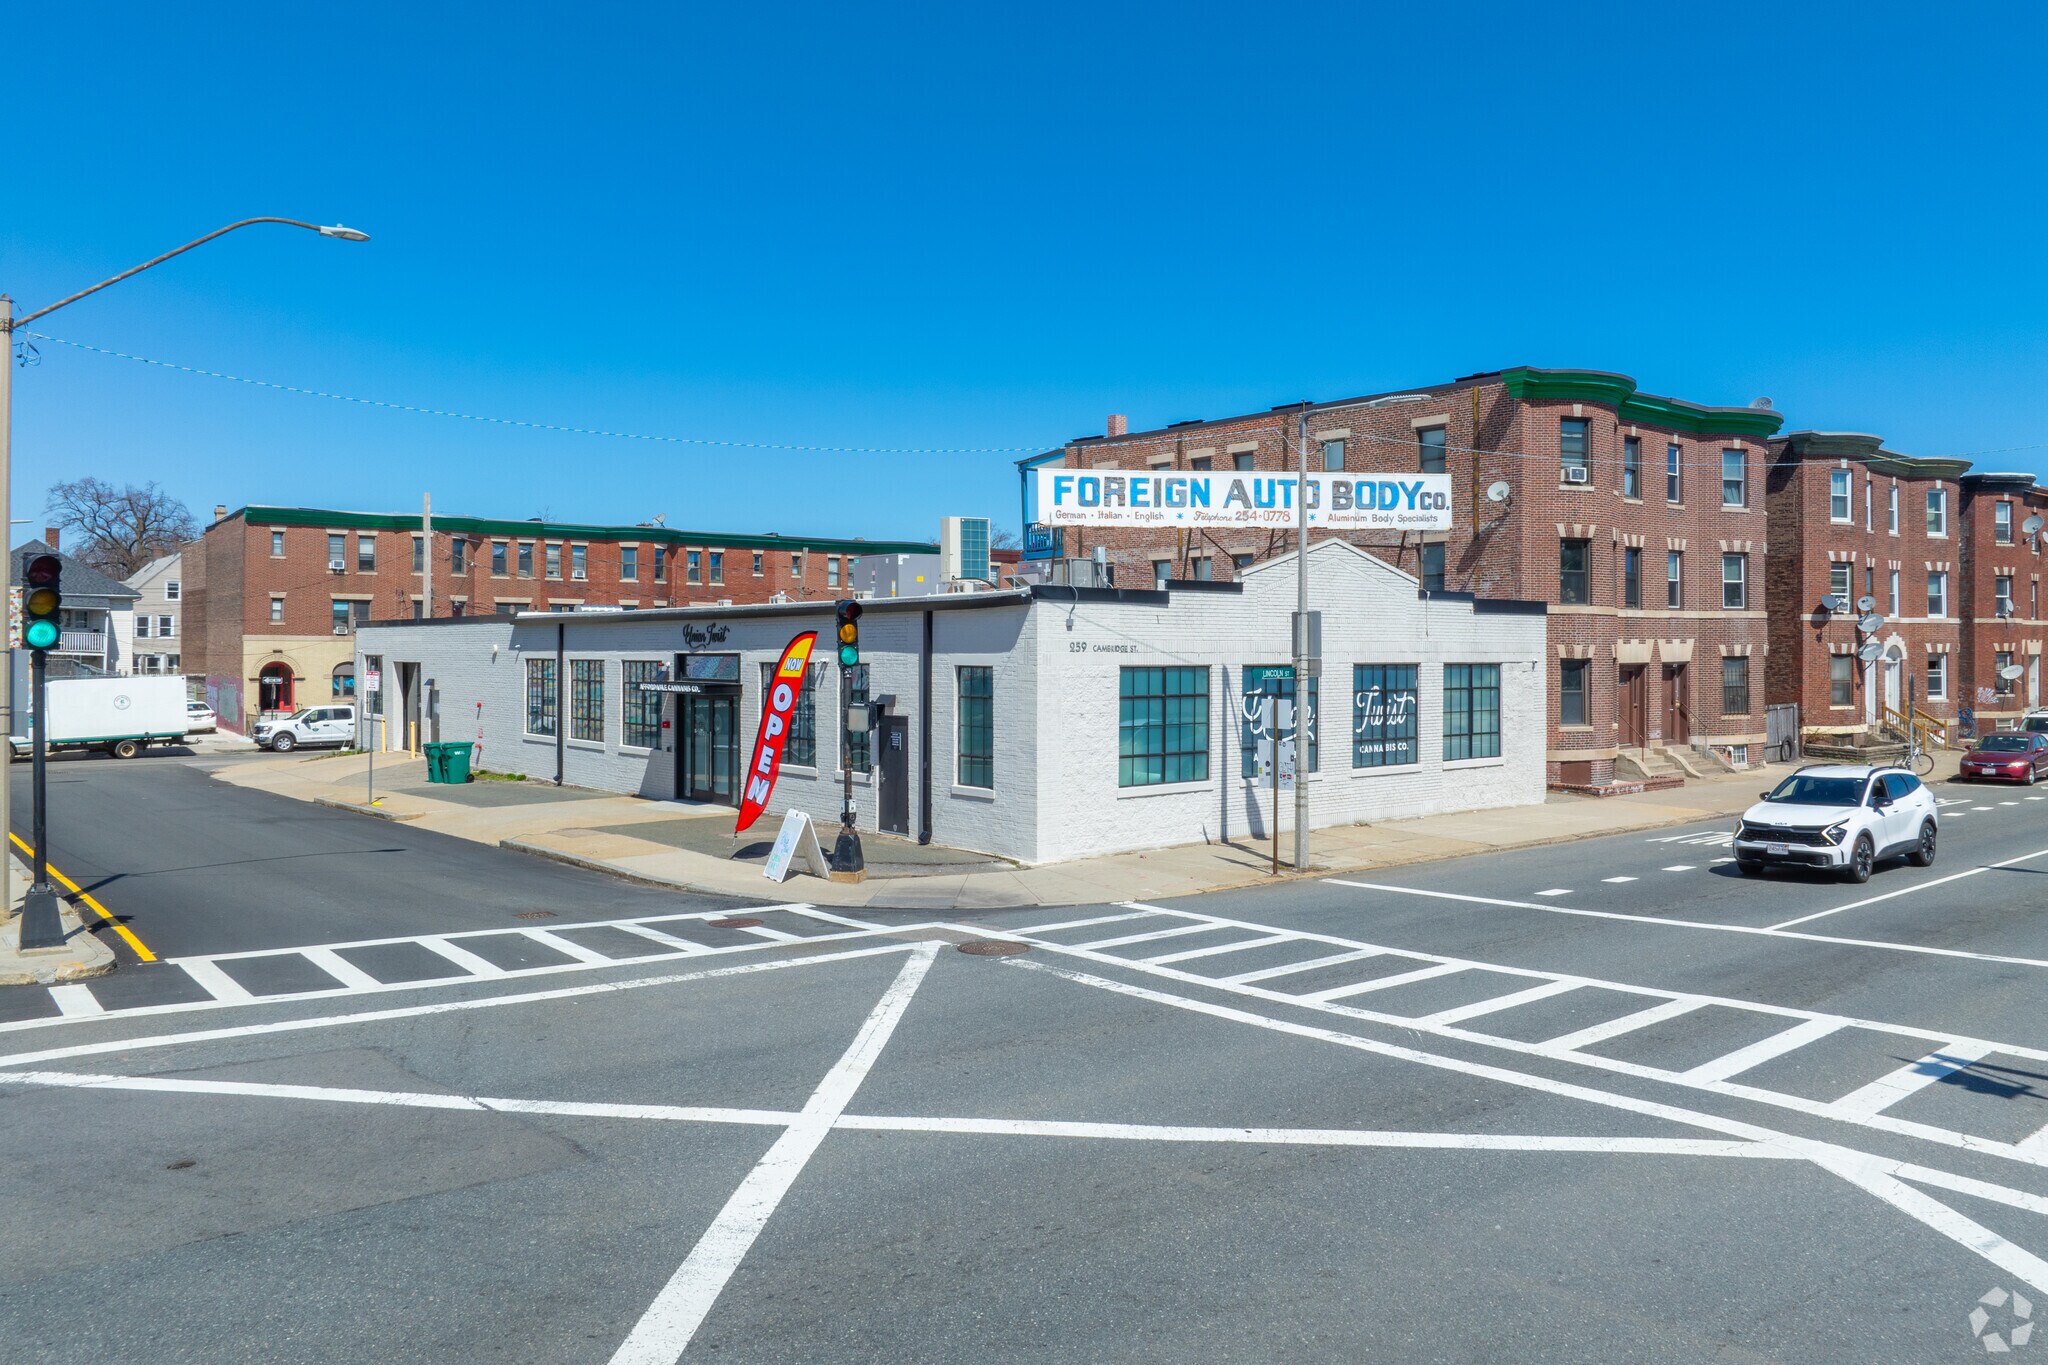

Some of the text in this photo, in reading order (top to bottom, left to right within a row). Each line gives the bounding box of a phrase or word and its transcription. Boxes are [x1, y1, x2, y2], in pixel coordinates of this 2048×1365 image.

[1053, 475, 1450, 511] FOREIGN AUTO BODY CO.
[1055, 509, 1087, 519] German
[1097, 511, 1123, 520] Italian
[1134, 511, 1165, 522] English
[1193, 510, 1233, 523] Telephone
[1327, 513, 1368, 522] Aluminum
[1371, 514, 1394, 526] Body
[1397, 513, 1438, 525] Specialists
[683, 622, 731, 649] Union Twist
[1069, 641, 1087, 653] 259
[1092, 644, 1128, 653] CAMBRIDGE
[783, 657, 804, 671] NOW
[1262, 669, 1284, 677] LINCOLN
[1355, 685, 1416, 733] Twist
[746, 683, 793, 806] OPEN
[1359, 742, 1409, 754] CANNABIS CO.
